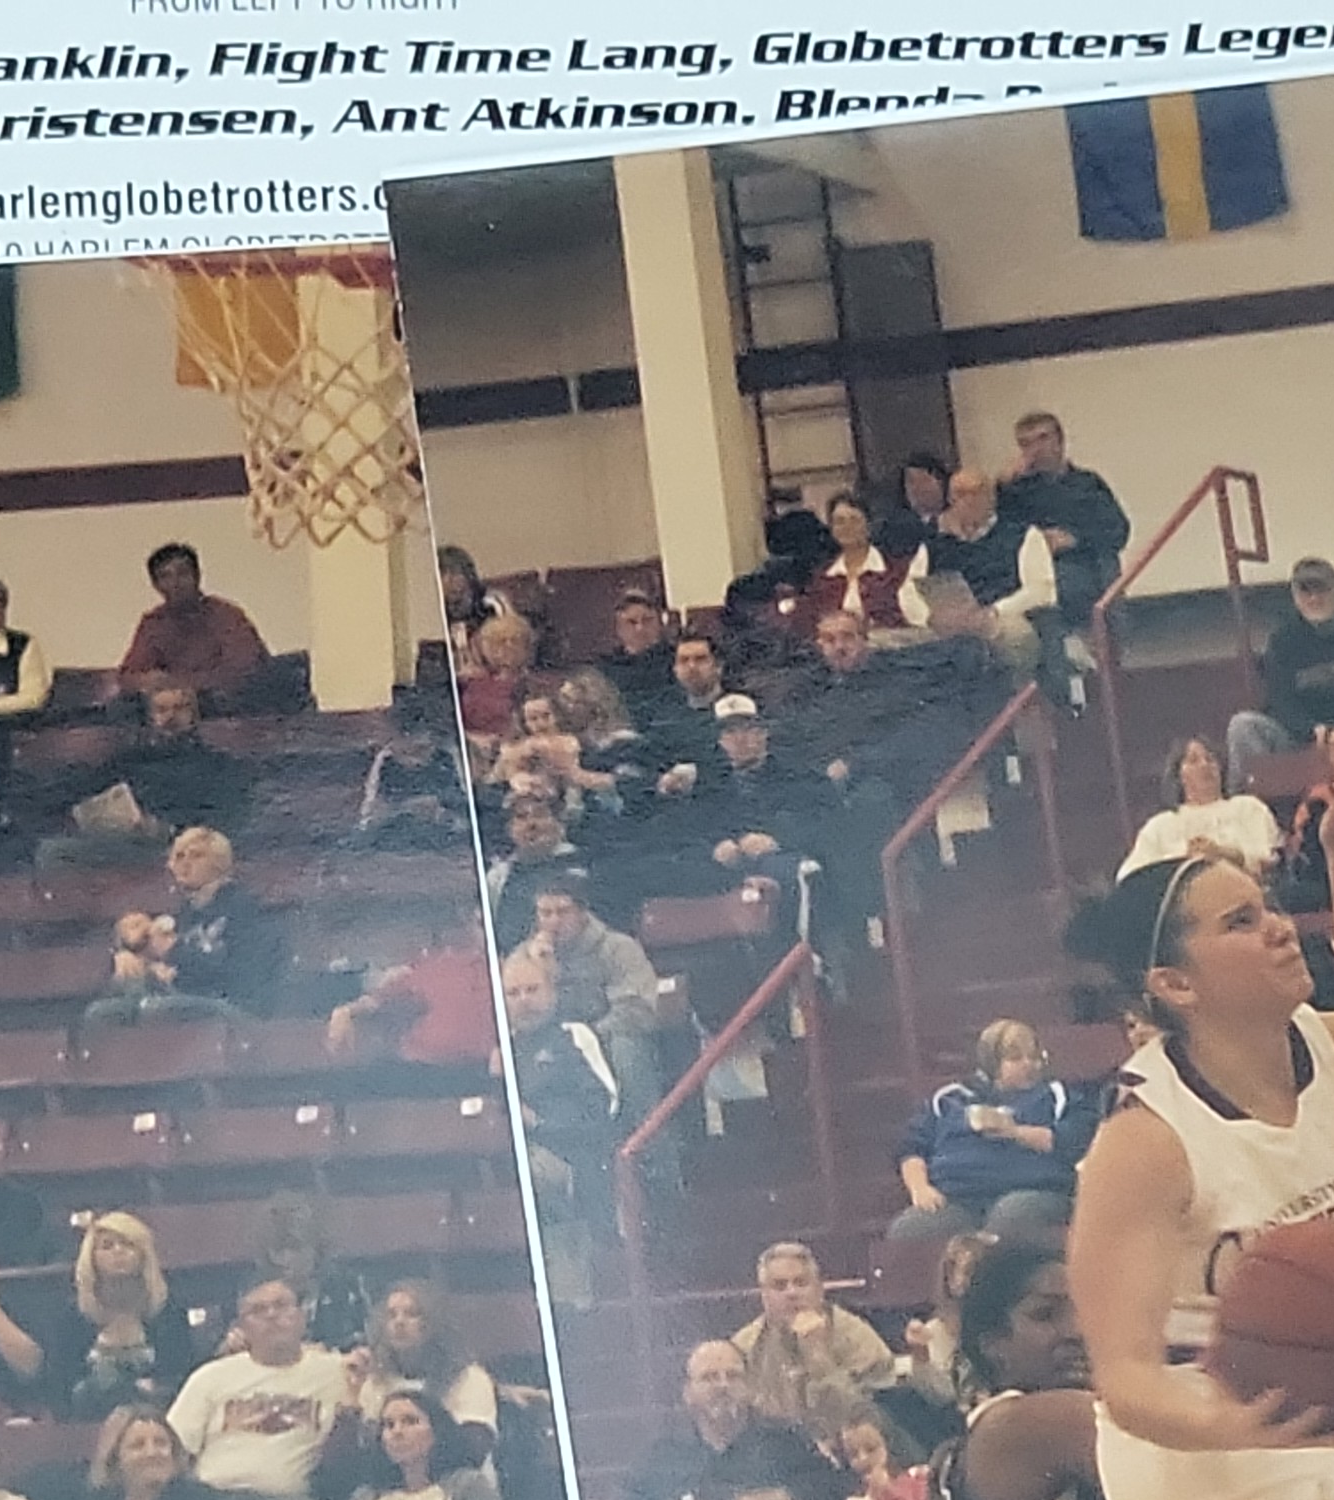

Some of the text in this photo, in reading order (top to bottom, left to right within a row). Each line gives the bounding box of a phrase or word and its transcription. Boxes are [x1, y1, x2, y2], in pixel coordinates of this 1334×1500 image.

[209, 41, 389, 84] Flight
[405, 40, 551, 74] Time
[567, 39, 733, 77] Lang,
[753, 22, 1169, 66] Globetrotters
[332, 99, 451, 133] Ant
[775, 85, 985, 122] Blend
